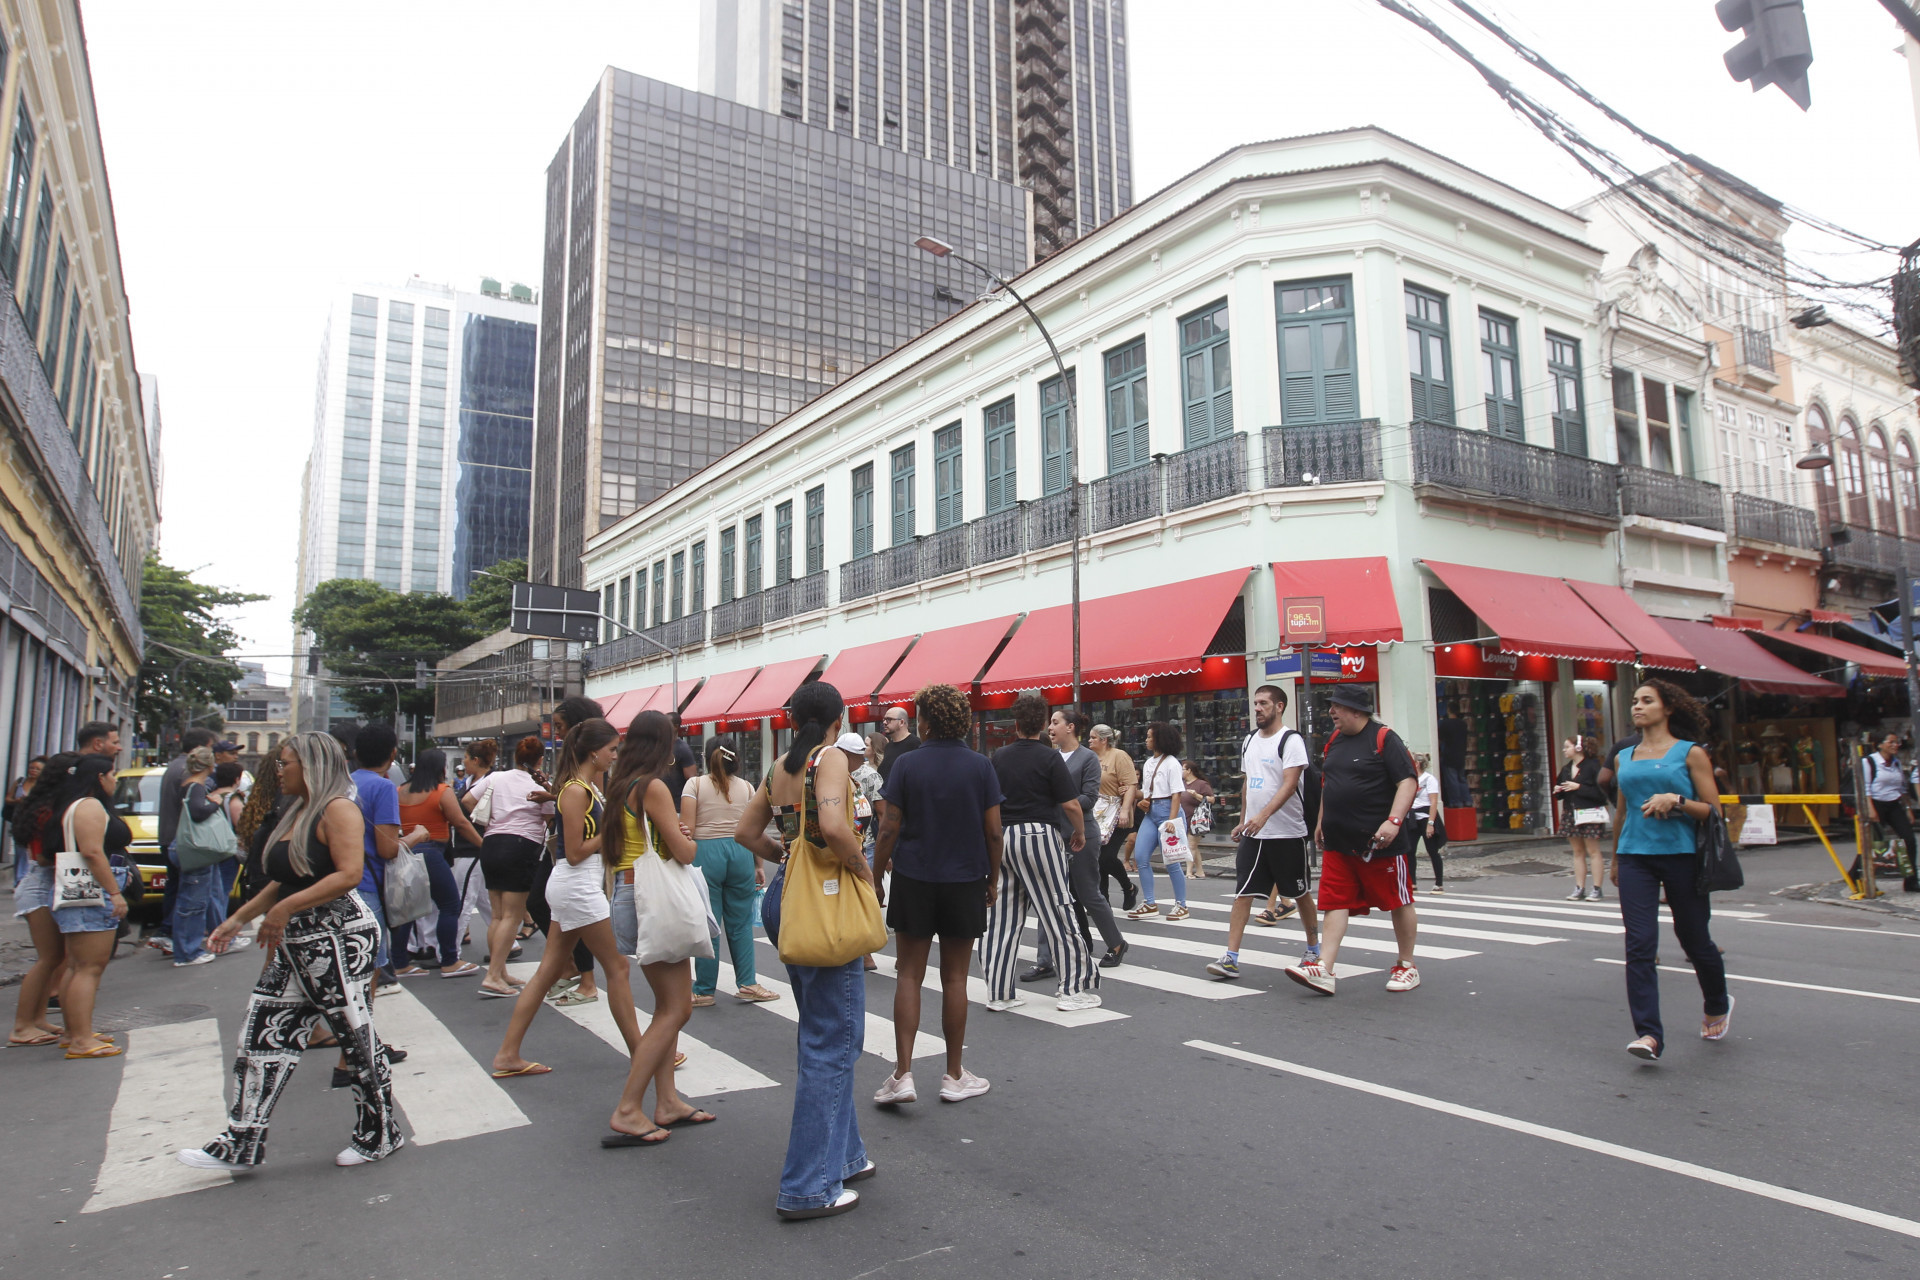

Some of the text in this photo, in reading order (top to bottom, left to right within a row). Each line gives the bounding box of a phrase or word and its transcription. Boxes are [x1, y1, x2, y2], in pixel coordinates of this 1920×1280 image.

[1293, 613, 1311, 621] 96.5
[1291, 618, 1319, 627] tupi.fm
[1482, 647, 1517, 671] Levany
